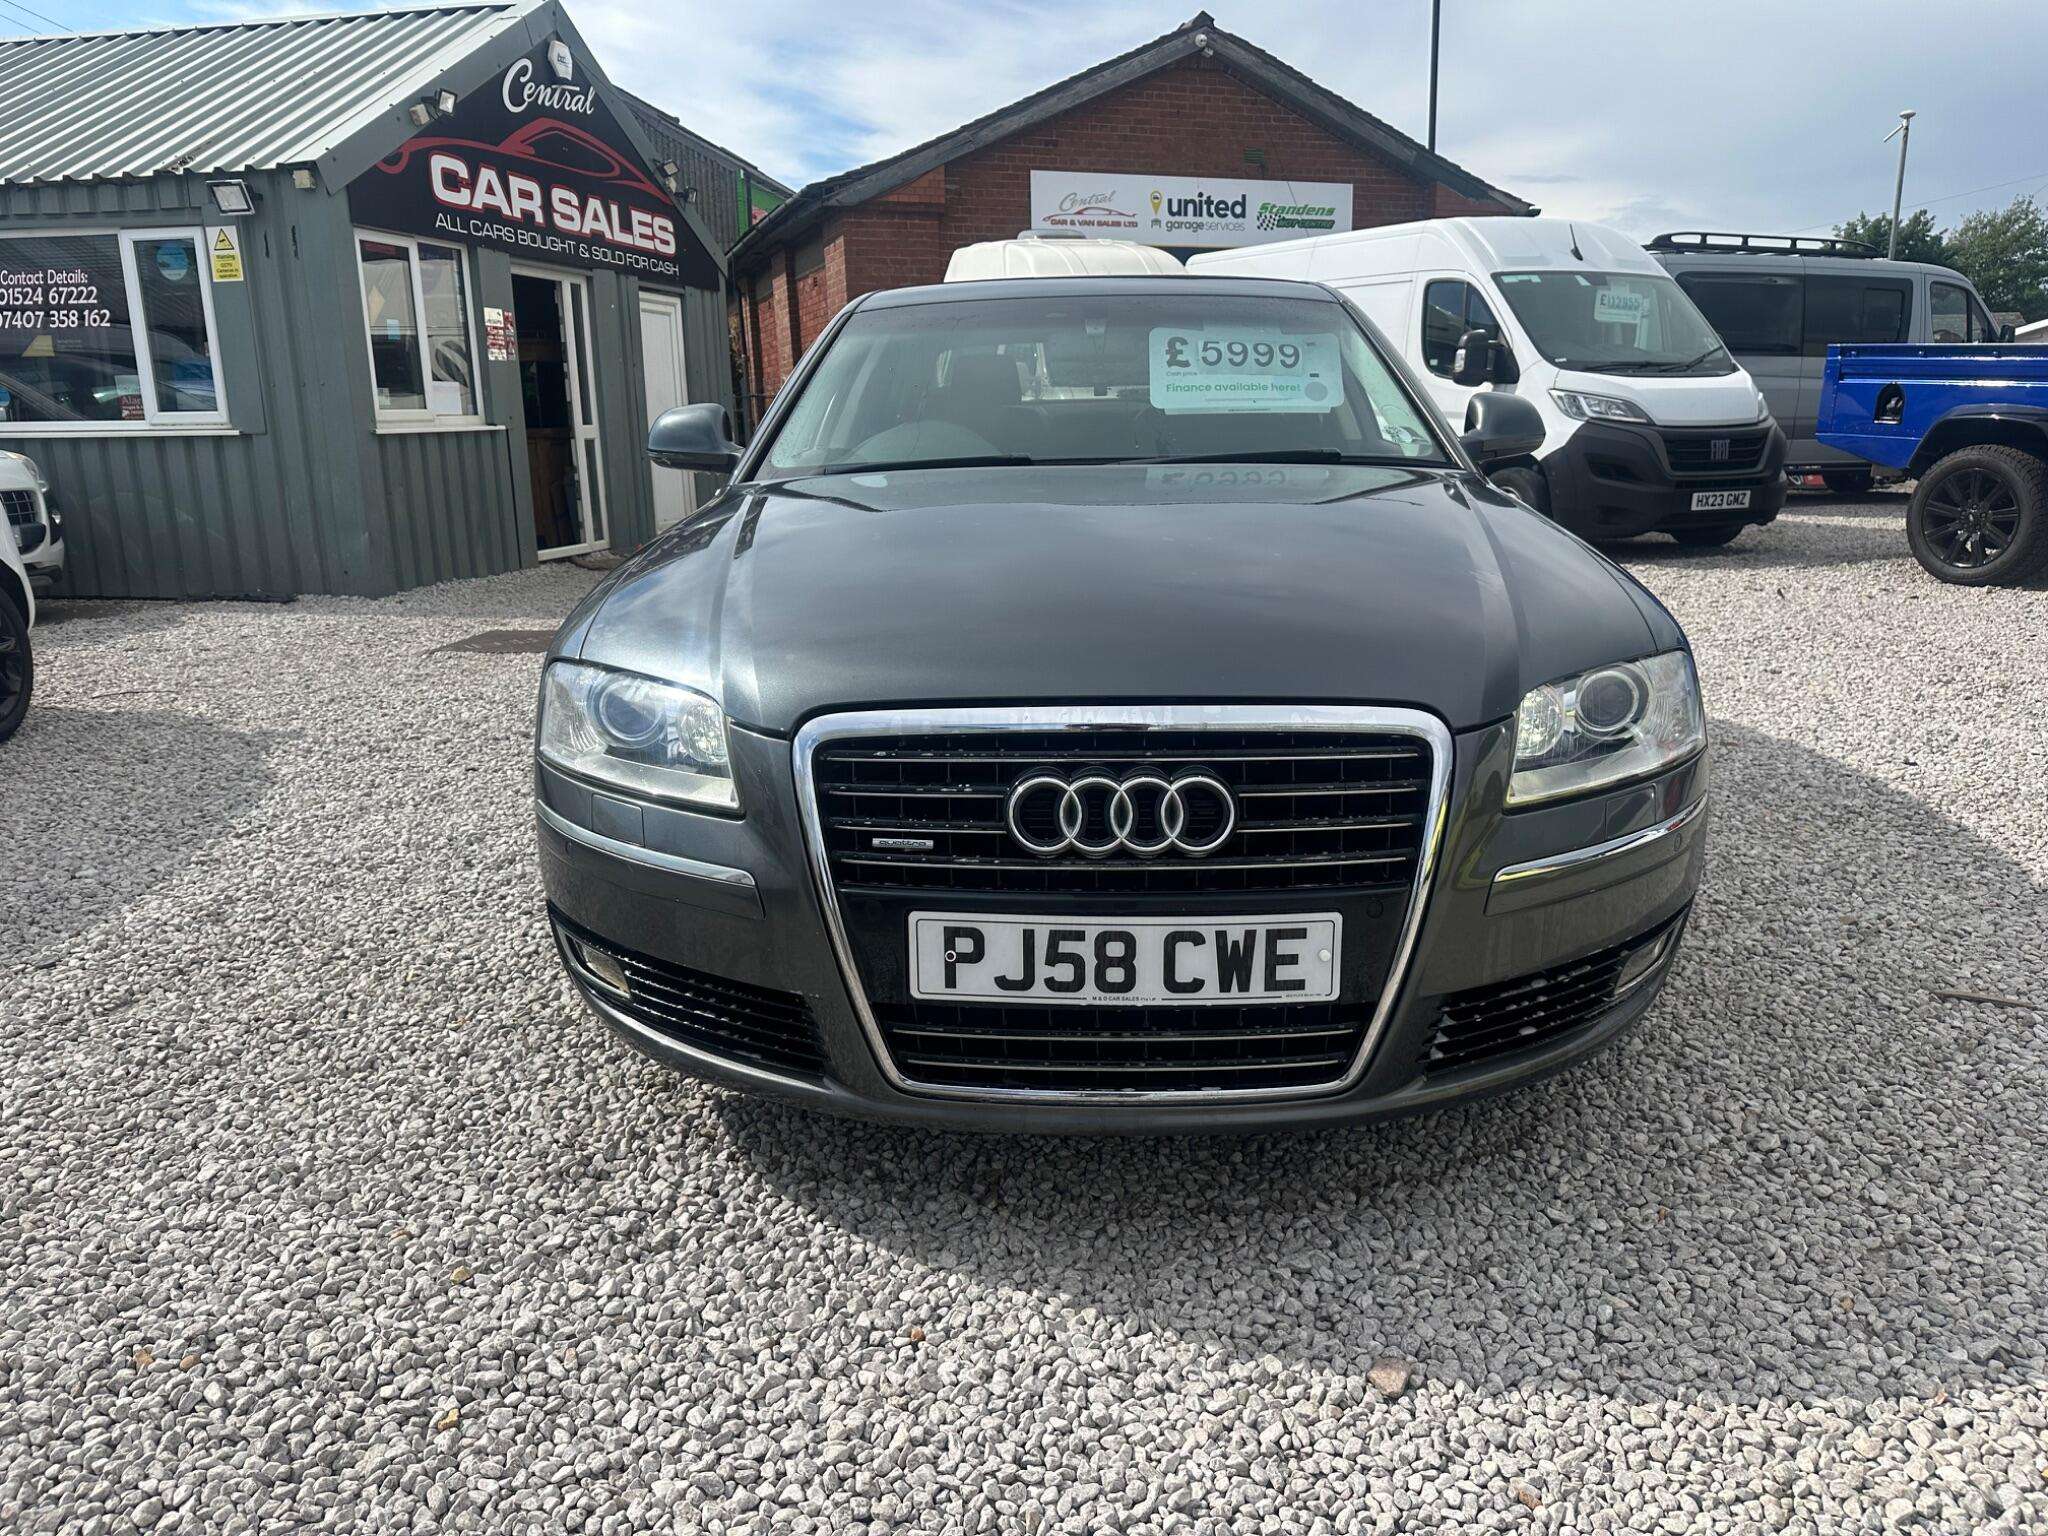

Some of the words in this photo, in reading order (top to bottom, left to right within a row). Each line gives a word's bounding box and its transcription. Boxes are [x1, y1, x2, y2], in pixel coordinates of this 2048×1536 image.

[502, 58, 596, 115] Central
[429, 154, 545, 226] CAR
[550, 186, 676, 256] SALES
[1059, 190, 1116, 212] Central
[1167, 192, 1247, 219] united
[1258, 202, 1336, 216] Standens
[1051, 218, 1067, 226] CAR
[1078, 219, 1095, 227] VAN
[1096, 220, 1122, 228] SALES
[1123, 220, 1138, 228] LTD
[435, 213, 468, 234] ALL
[470, 220, 515, 243] CARS
[518, 230, 577, 254] BOUGHT
[579, 244, 590, 258] &
[592, 245, 625, 265] SOLD
[627, 252, 649, 270] FOR
[650, 257, 680, 276] CASH
[1, 269, 44, 285] Contact
[47, 268, 88, 284] Details:
[0, 287, 43, 305] 01524
[49, 286, 98, 304] 67222
[0, 310, 44, 328] 7407
[50, 310, 78, 328] 358
[84, 310, 111, 328] 162
[1166, 383, 1211, 393] Finance
[1214, 382, 1269, 392] available
[1271, 383, 1301, 392] here!
[1711, 440, 1730, 460] FIAT
[1696, 493, 1724, 508] HX23
[1726, 492, 1747, 506] GMZ
[943, 926, 1137, 993] PJ58
[1163, 927, 1308, 994] CWE
